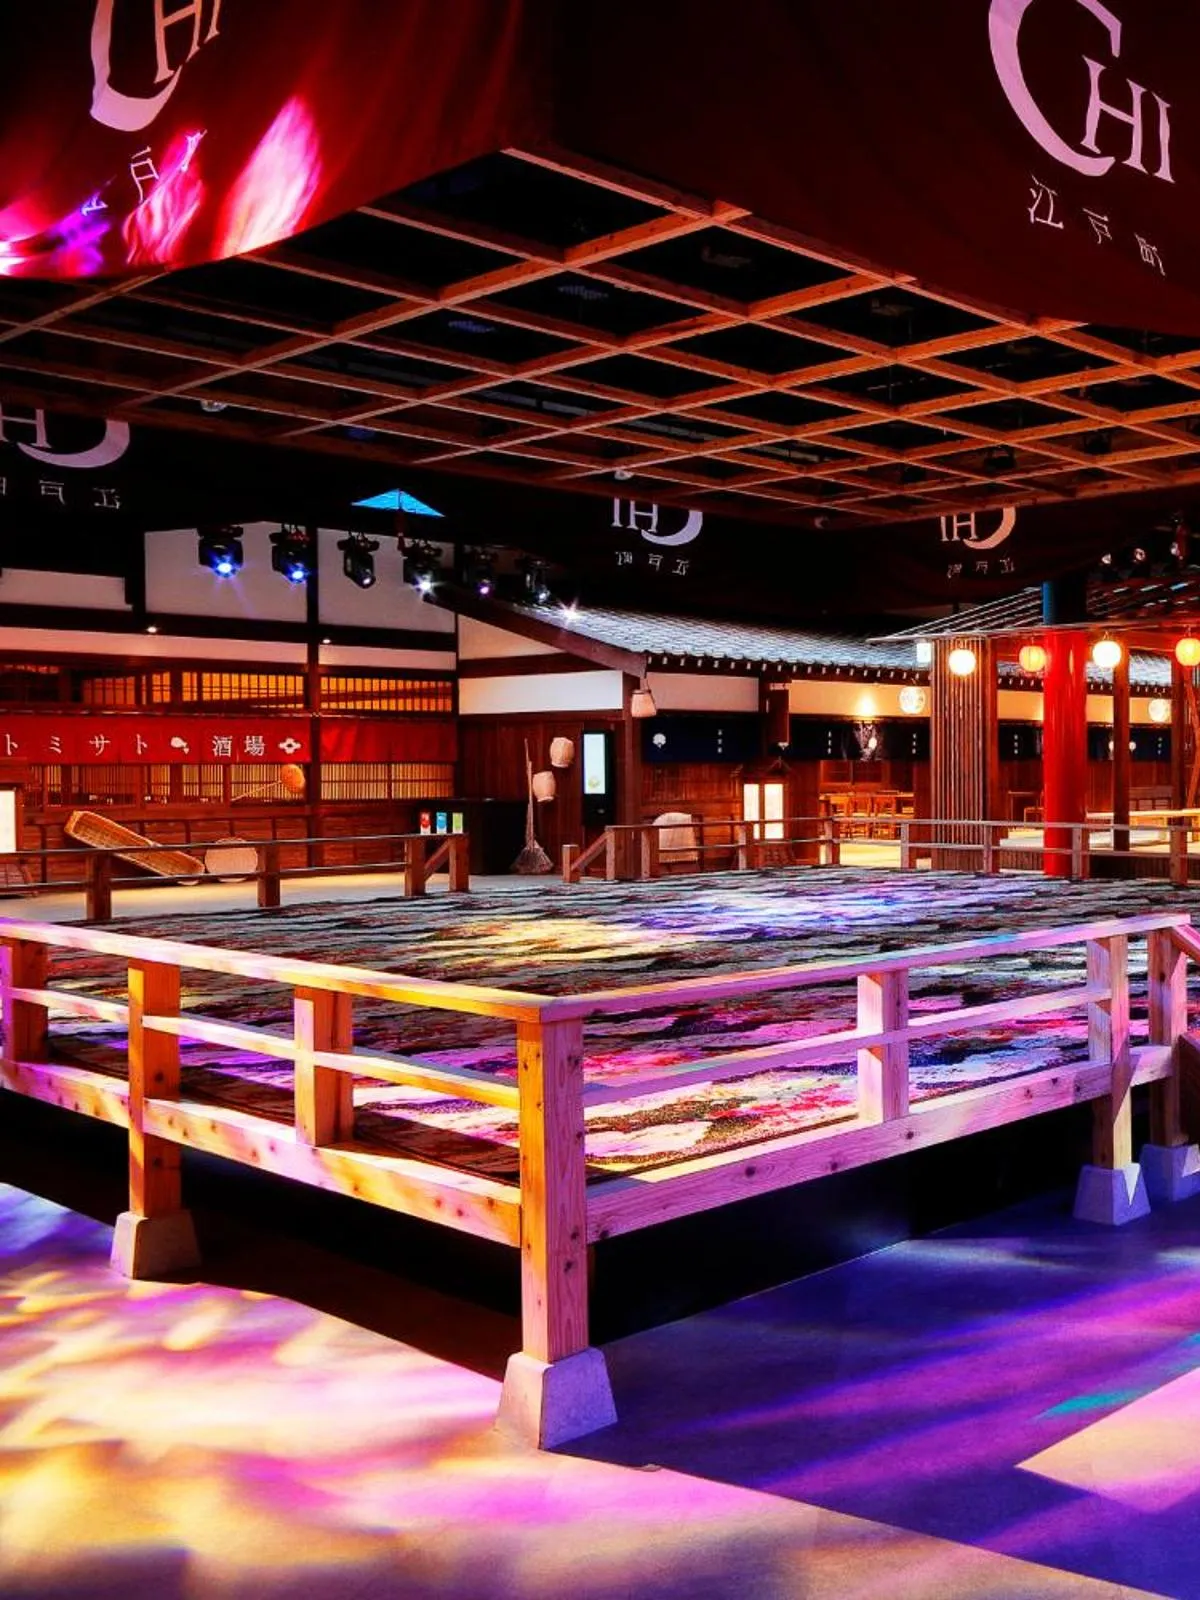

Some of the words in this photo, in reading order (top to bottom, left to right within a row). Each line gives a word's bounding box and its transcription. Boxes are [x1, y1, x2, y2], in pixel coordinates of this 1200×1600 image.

[988, 0, 1175, 183] CHI
[4, 733, 149, 757] トミサト
[211, 734, 266, 757] 酒場
